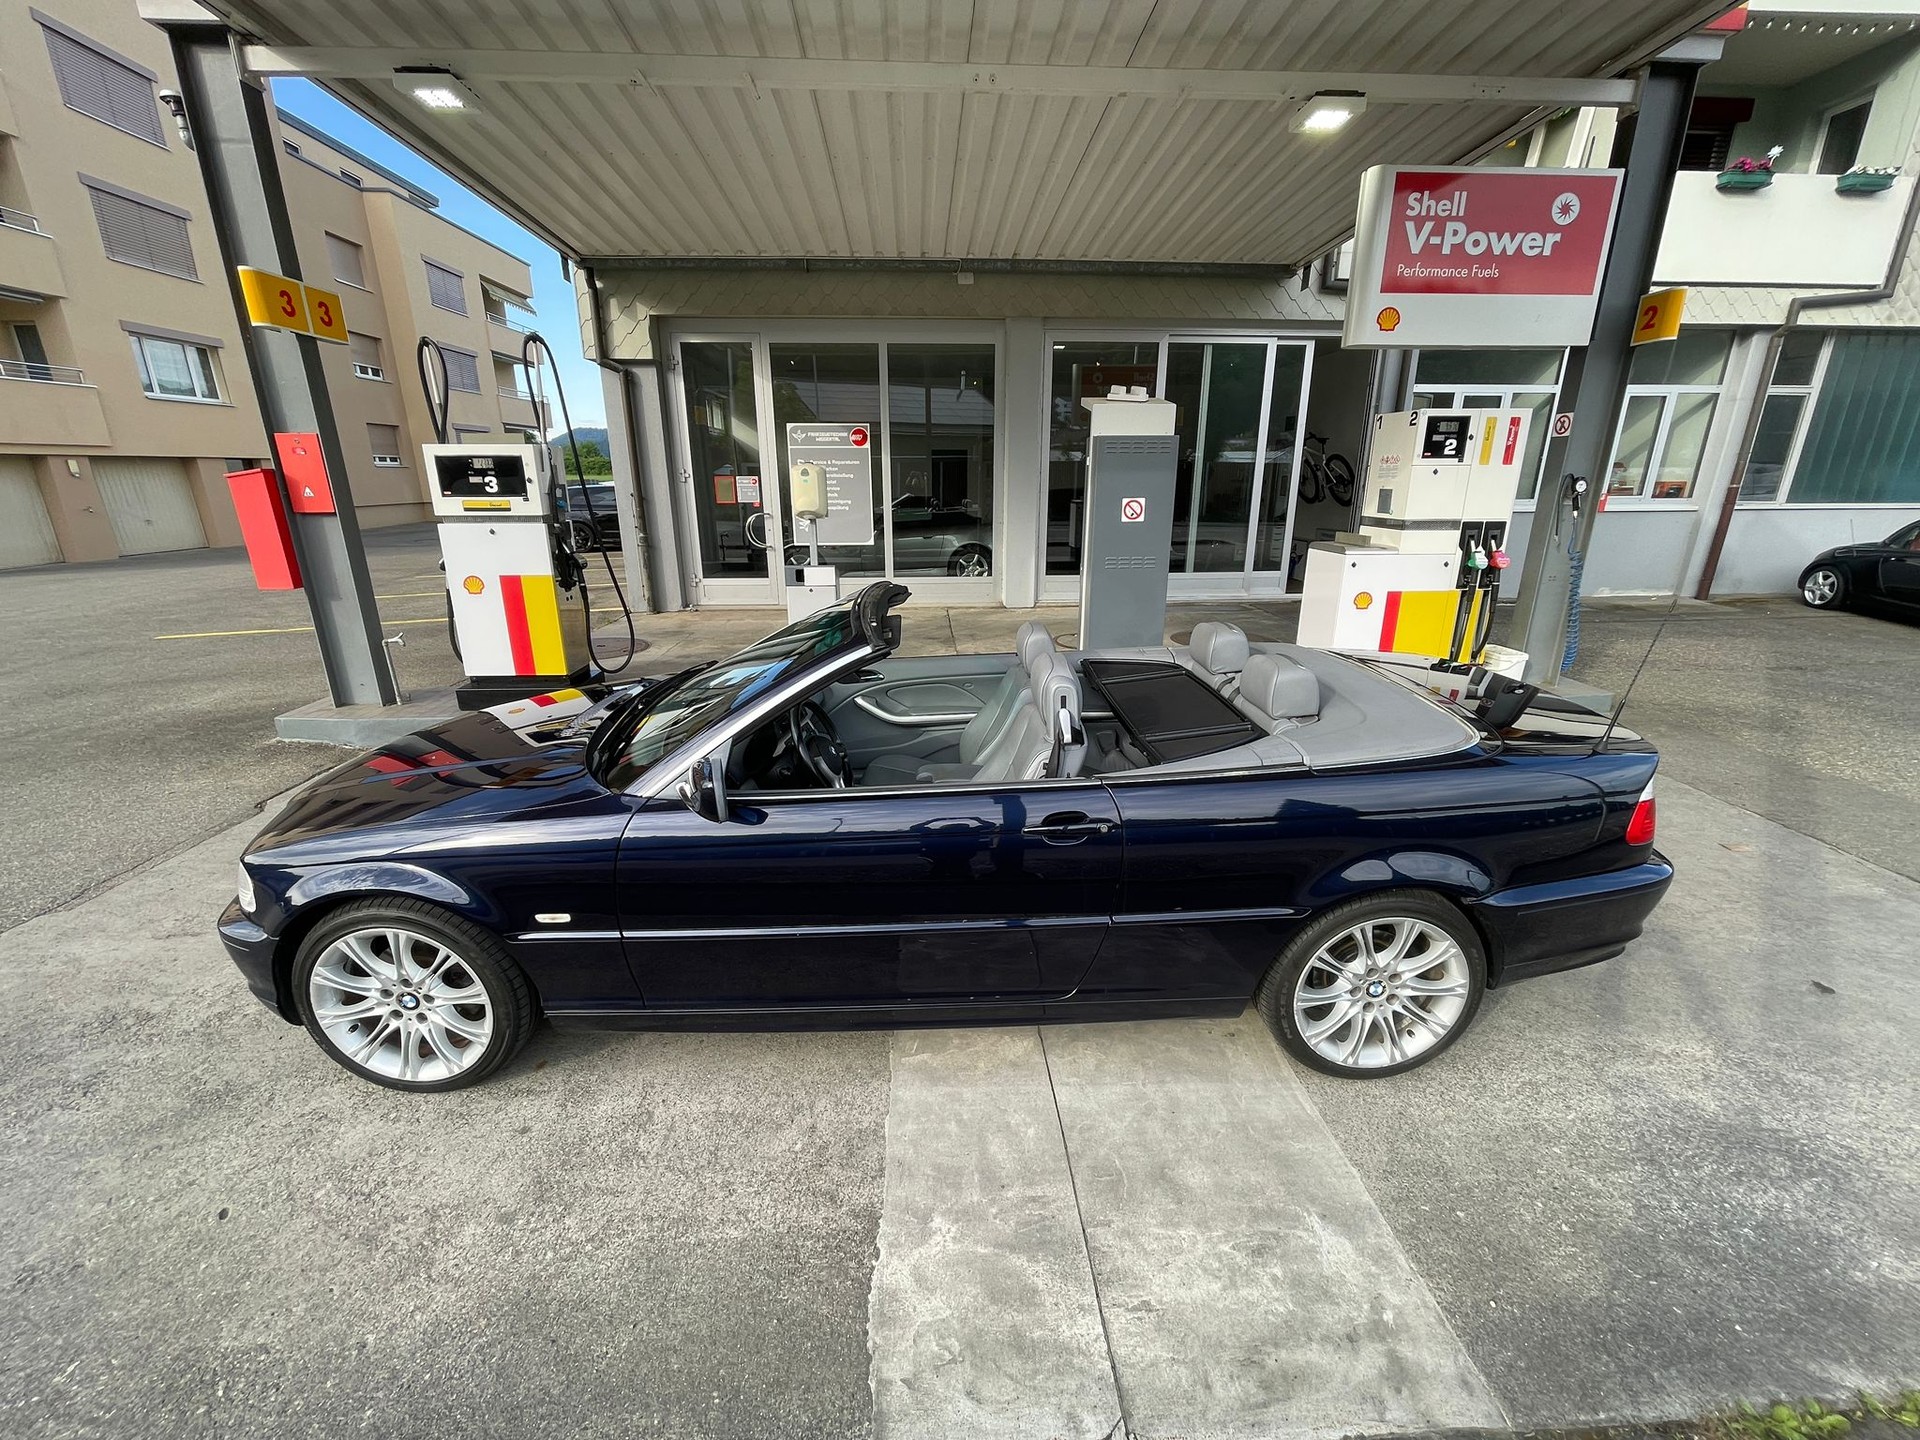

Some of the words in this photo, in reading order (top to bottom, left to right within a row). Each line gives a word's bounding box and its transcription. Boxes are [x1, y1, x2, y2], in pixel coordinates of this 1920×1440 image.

[1406, 191, 1467, 217] Shell
[1405, 221, 1561, 256] V-Power
[1397, 262, 1468, 278] Performance
[1471, 264, 1499, 278] Fuels
[279, 290, 296, 318] 3
[318, 301, 333, 328] 3
[1640, 305, 1659, 332] 2
[1376, 415, 1383, 430] 1
[1409, 411, 1418, 427] 2
[1444, 439, 1457, 454] 2
[483, 476, 499, 493] 3
